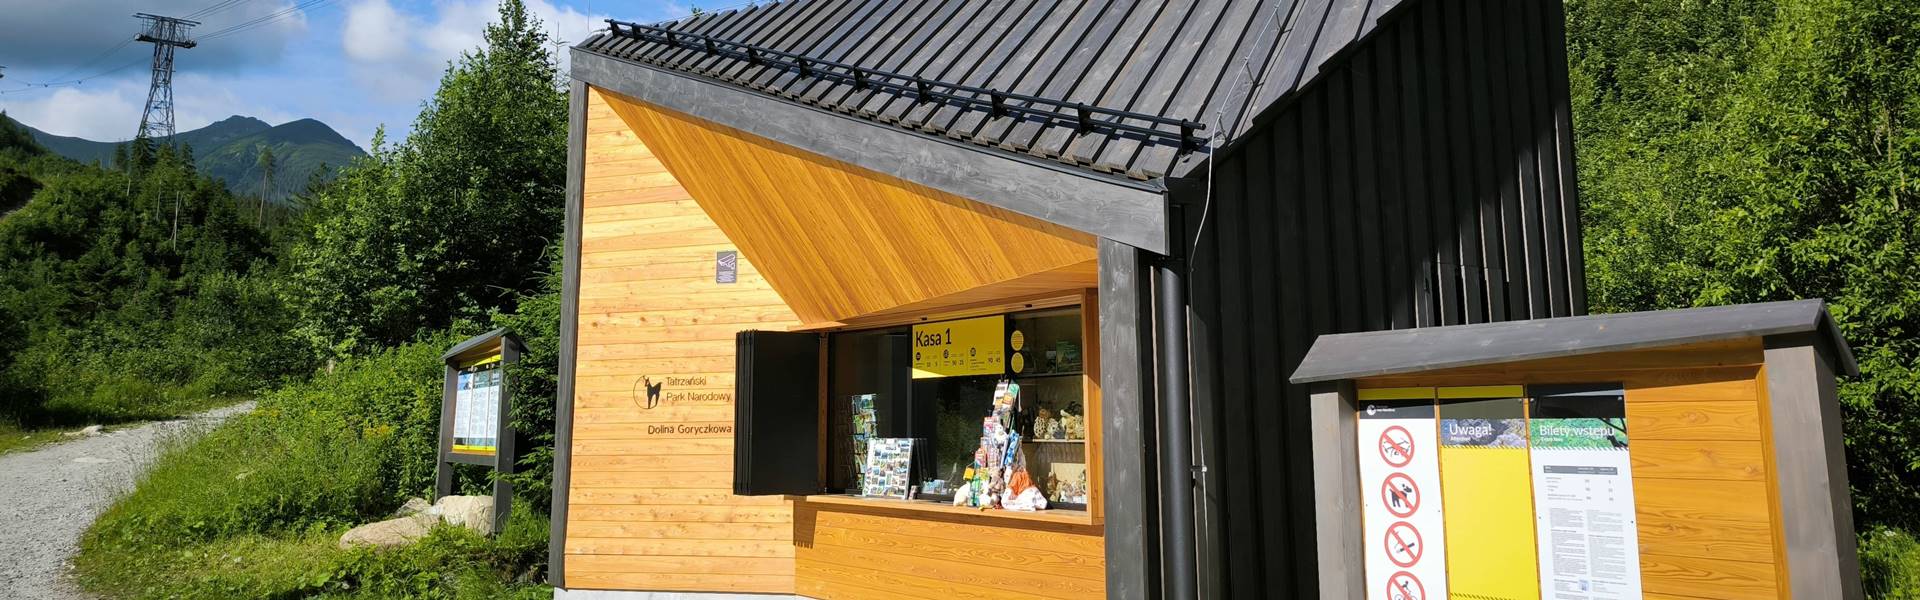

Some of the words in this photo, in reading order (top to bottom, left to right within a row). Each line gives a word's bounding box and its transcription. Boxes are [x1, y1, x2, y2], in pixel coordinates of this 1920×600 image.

[916, 331, 942, 348] Kasa
[945, 328, 952, 345] 1
[666, 376, 707, 386] Tatrzański
[666, 392, 685, 402] Park
[687, 392, 731, 402] Narodowy
[648, 425, 675, 435] Dolina
[678, 424, 732, 435] Goryczkowa
[1449, 423, 1492, 438] Uwaga!
[1540, 425, 1570, 437] Bilety
